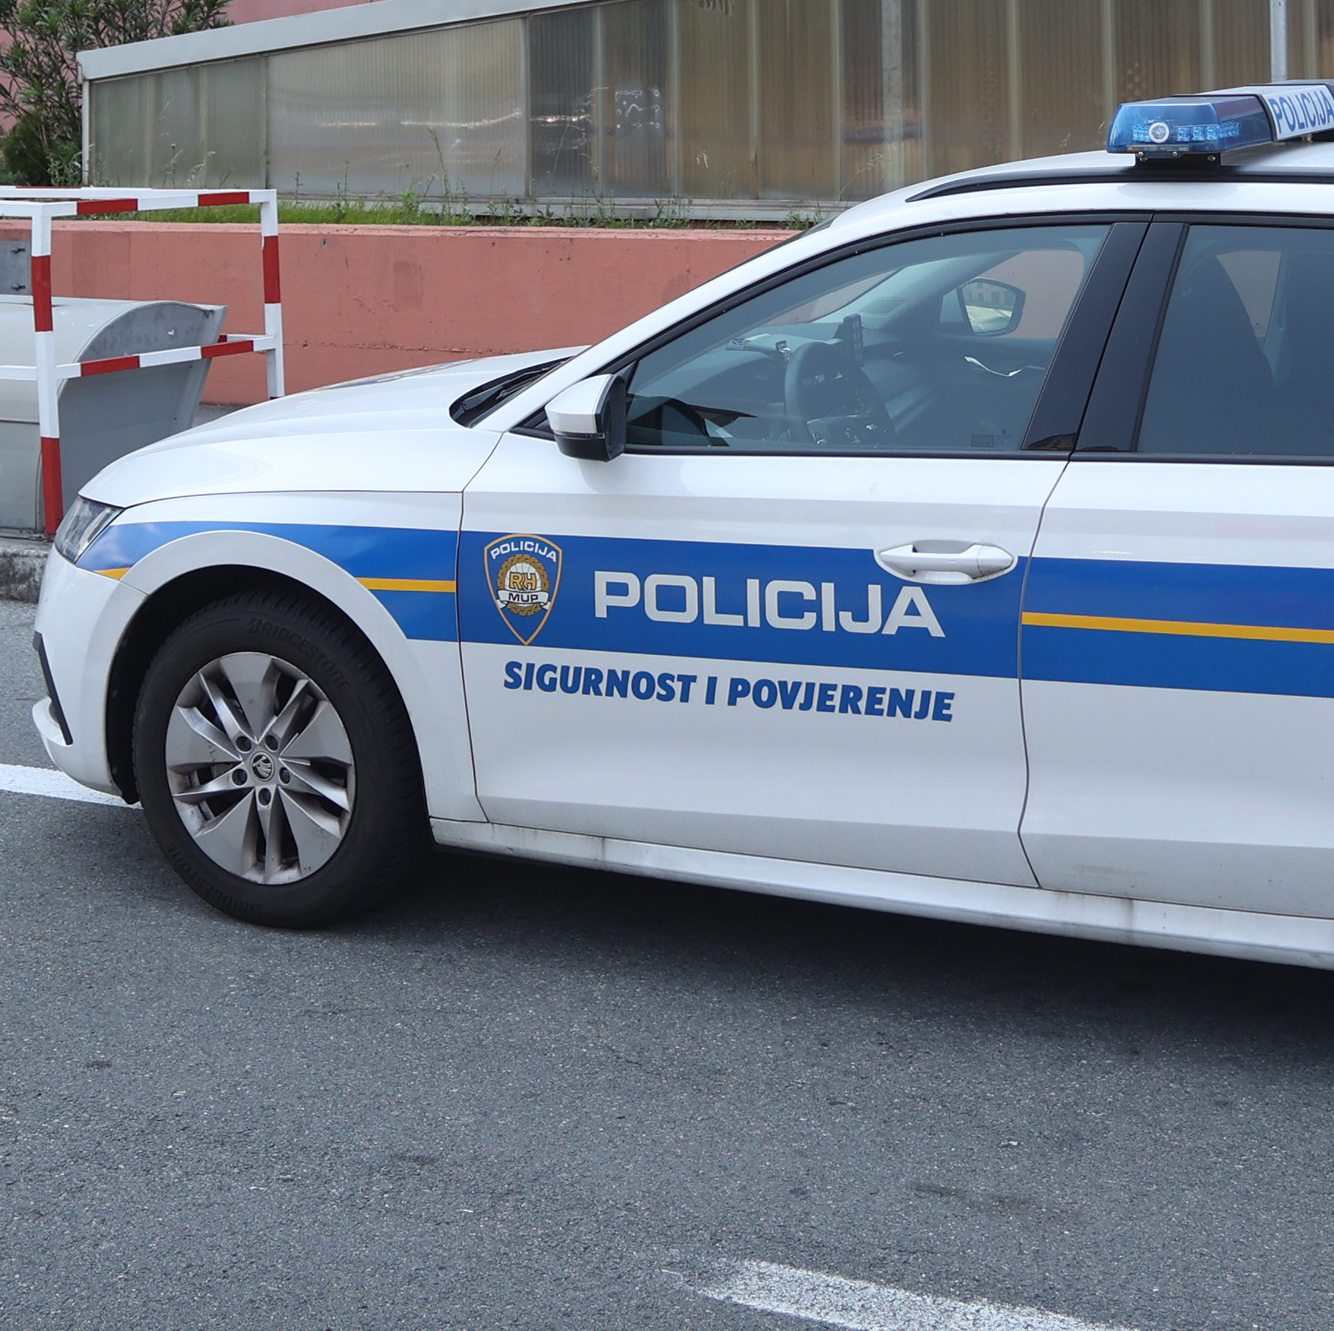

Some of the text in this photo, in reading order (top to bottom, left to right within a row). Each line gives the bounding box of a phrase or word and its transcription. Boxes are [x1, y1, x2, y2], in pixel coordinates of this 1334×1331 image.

[490, 541, 557, 562] POLICIJA
[508, 571, 538, 591] RH
[508, 593, 539, 603] MUP
[594, 570, 946, 638] POLICIJA
[503, 660, 956, 723] SIGURNOST I POVJERENJE
